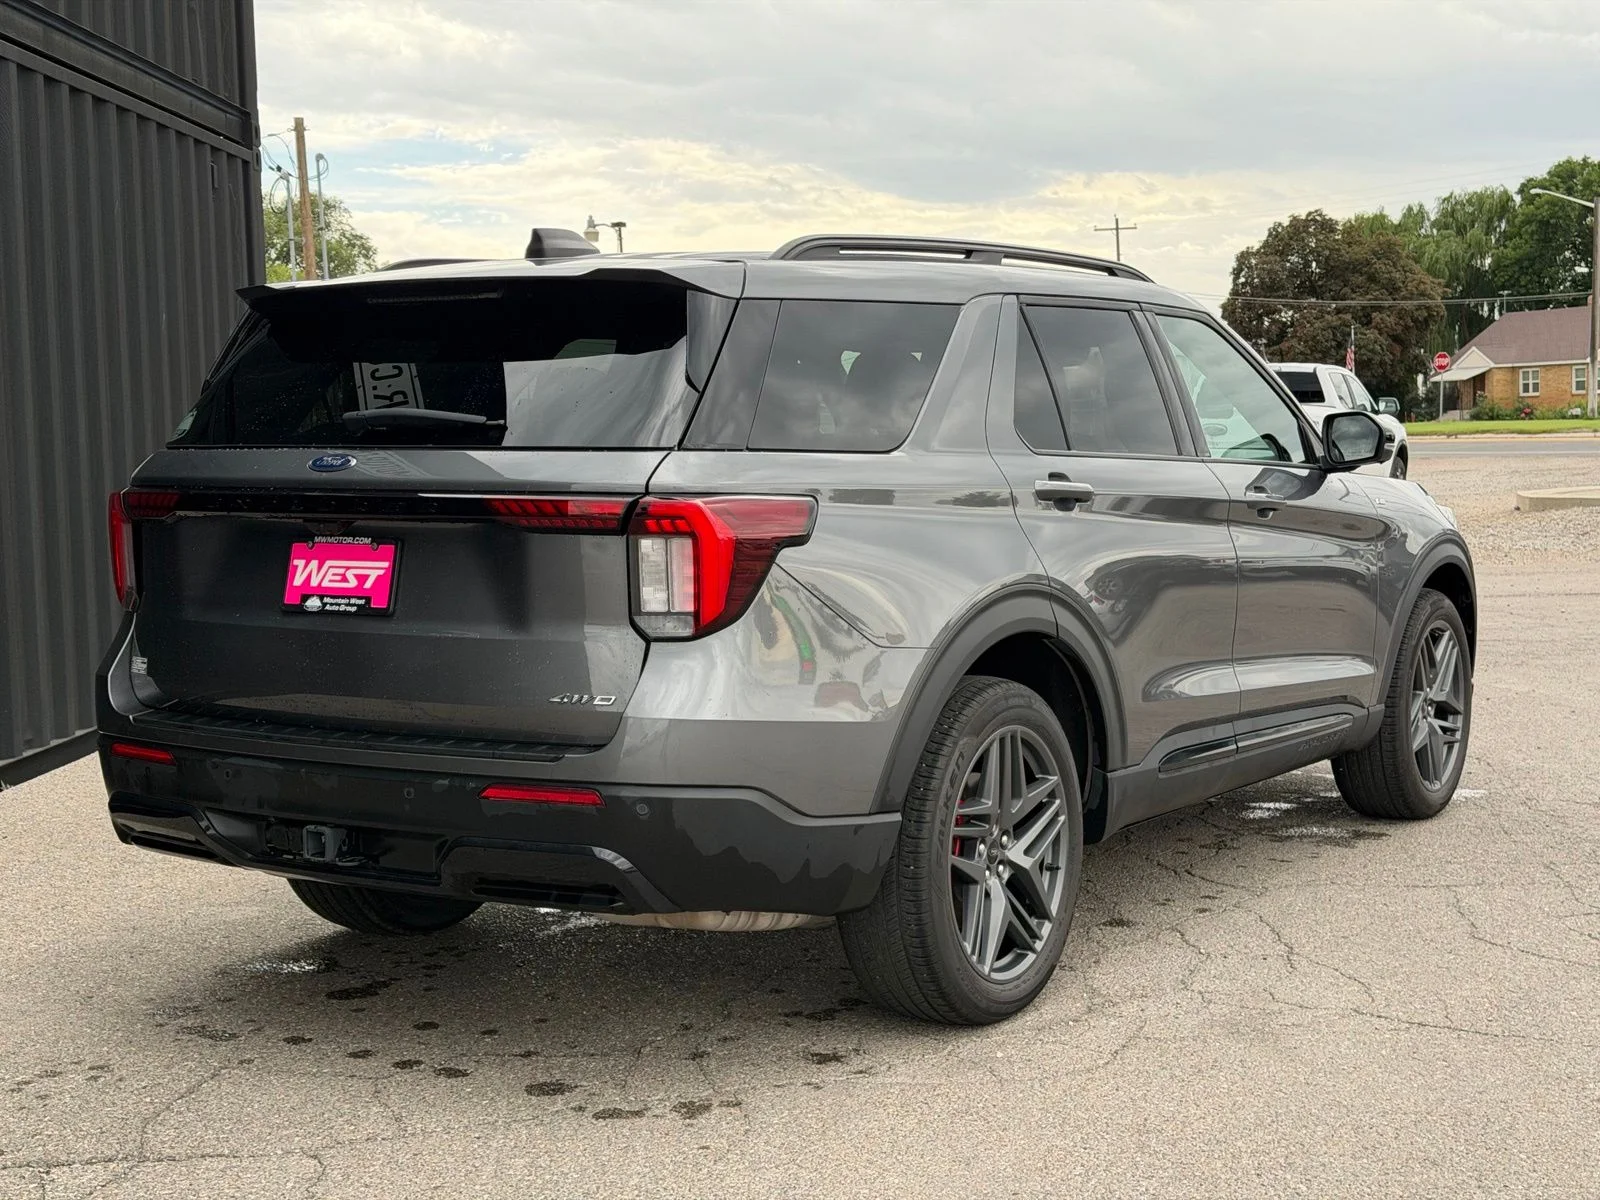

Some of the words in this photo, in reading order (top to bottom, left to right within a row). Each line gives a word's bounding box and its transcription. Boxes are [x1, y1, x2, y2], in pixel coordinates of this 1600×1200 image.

[1434, 357, 1450, 367] STOP
[313, 536, 372, 545] MWMOTOR.COM
[292, 559, 390, 589] WEST
[322, 596, 349, 604] Mountain
[350, 597, 366, 605] West
[339, 604, 357, 613] Group
